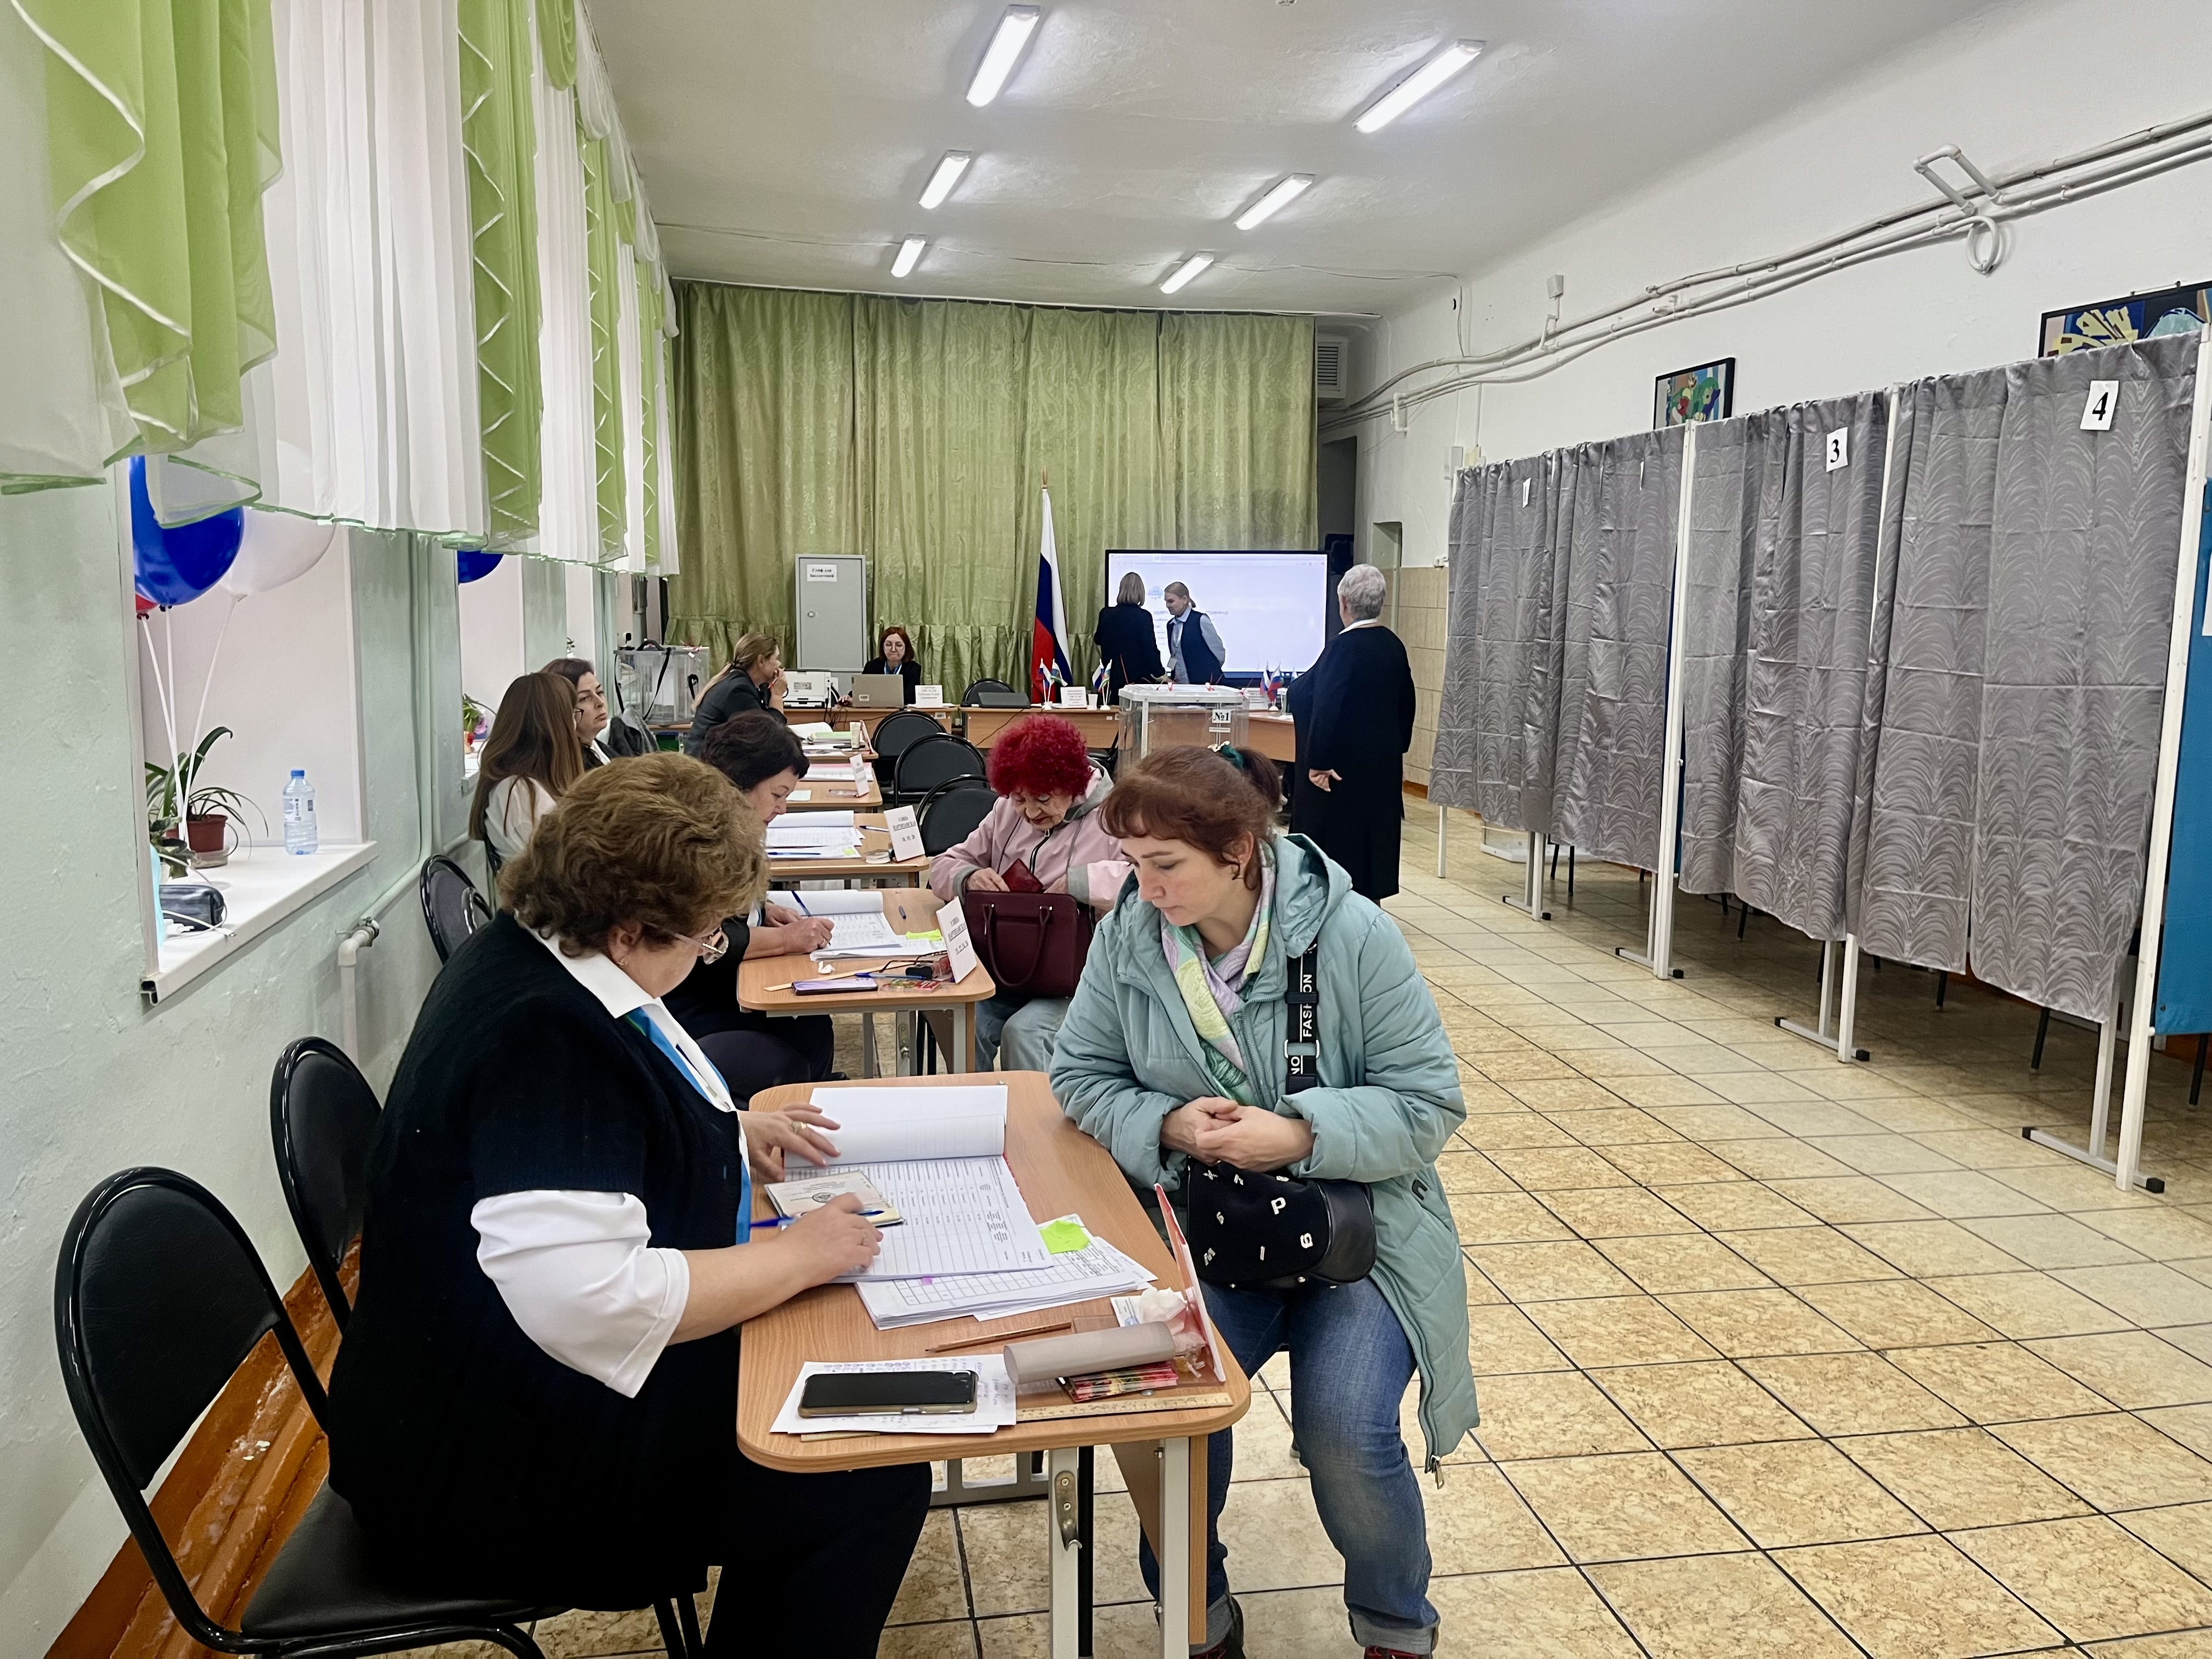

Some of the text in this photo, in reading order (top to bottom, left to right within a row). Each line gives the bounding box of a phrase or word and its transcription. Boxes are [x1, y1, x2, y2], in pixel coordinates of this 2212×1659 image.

[2092, 392, 2108, 421] 4
[1830, 438, 1840, 463] 3
[1213, 712, 1229, 721] №1
[1302, 974, 1312, 1037] FASHON
[1271, 1197, 1286, 1215] P
